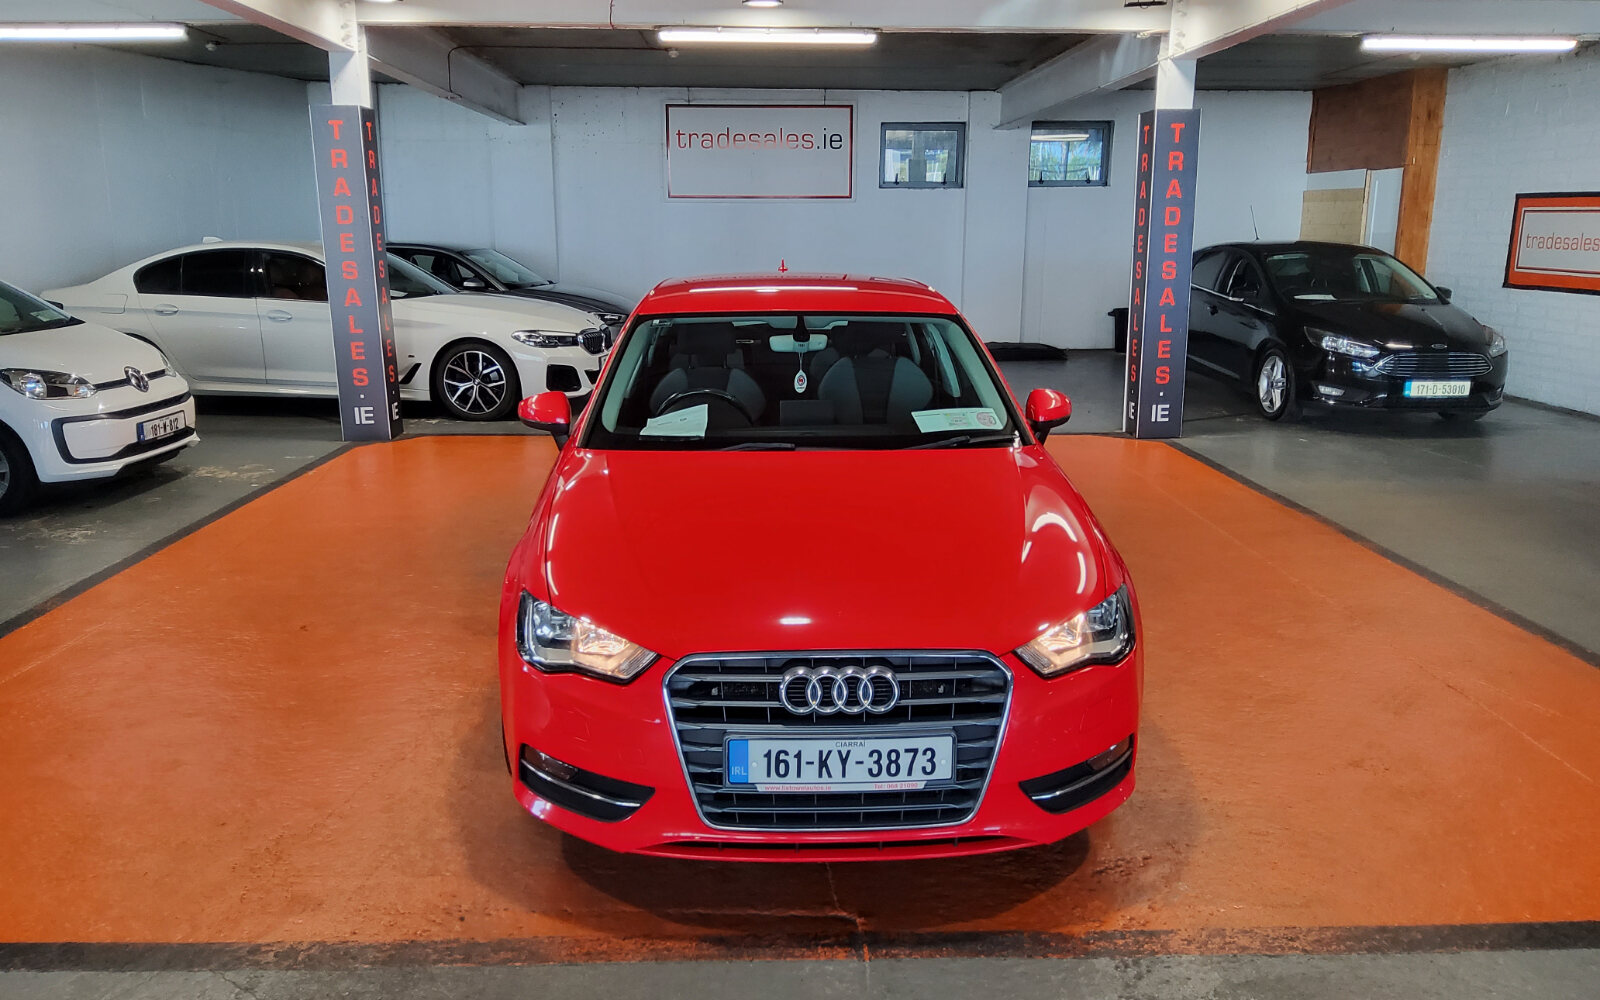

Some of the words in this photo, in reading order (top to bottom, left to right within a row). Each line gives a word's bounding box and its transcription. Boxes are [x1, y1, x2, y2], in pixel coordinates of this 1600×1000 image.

[675, 127, 843, 150] tradesales.ie
[1525, 231, 1600, 252] tradesales
[731, 766, 748, 776] IRL
[763, 747, 937, 779] 161-KY-3873
